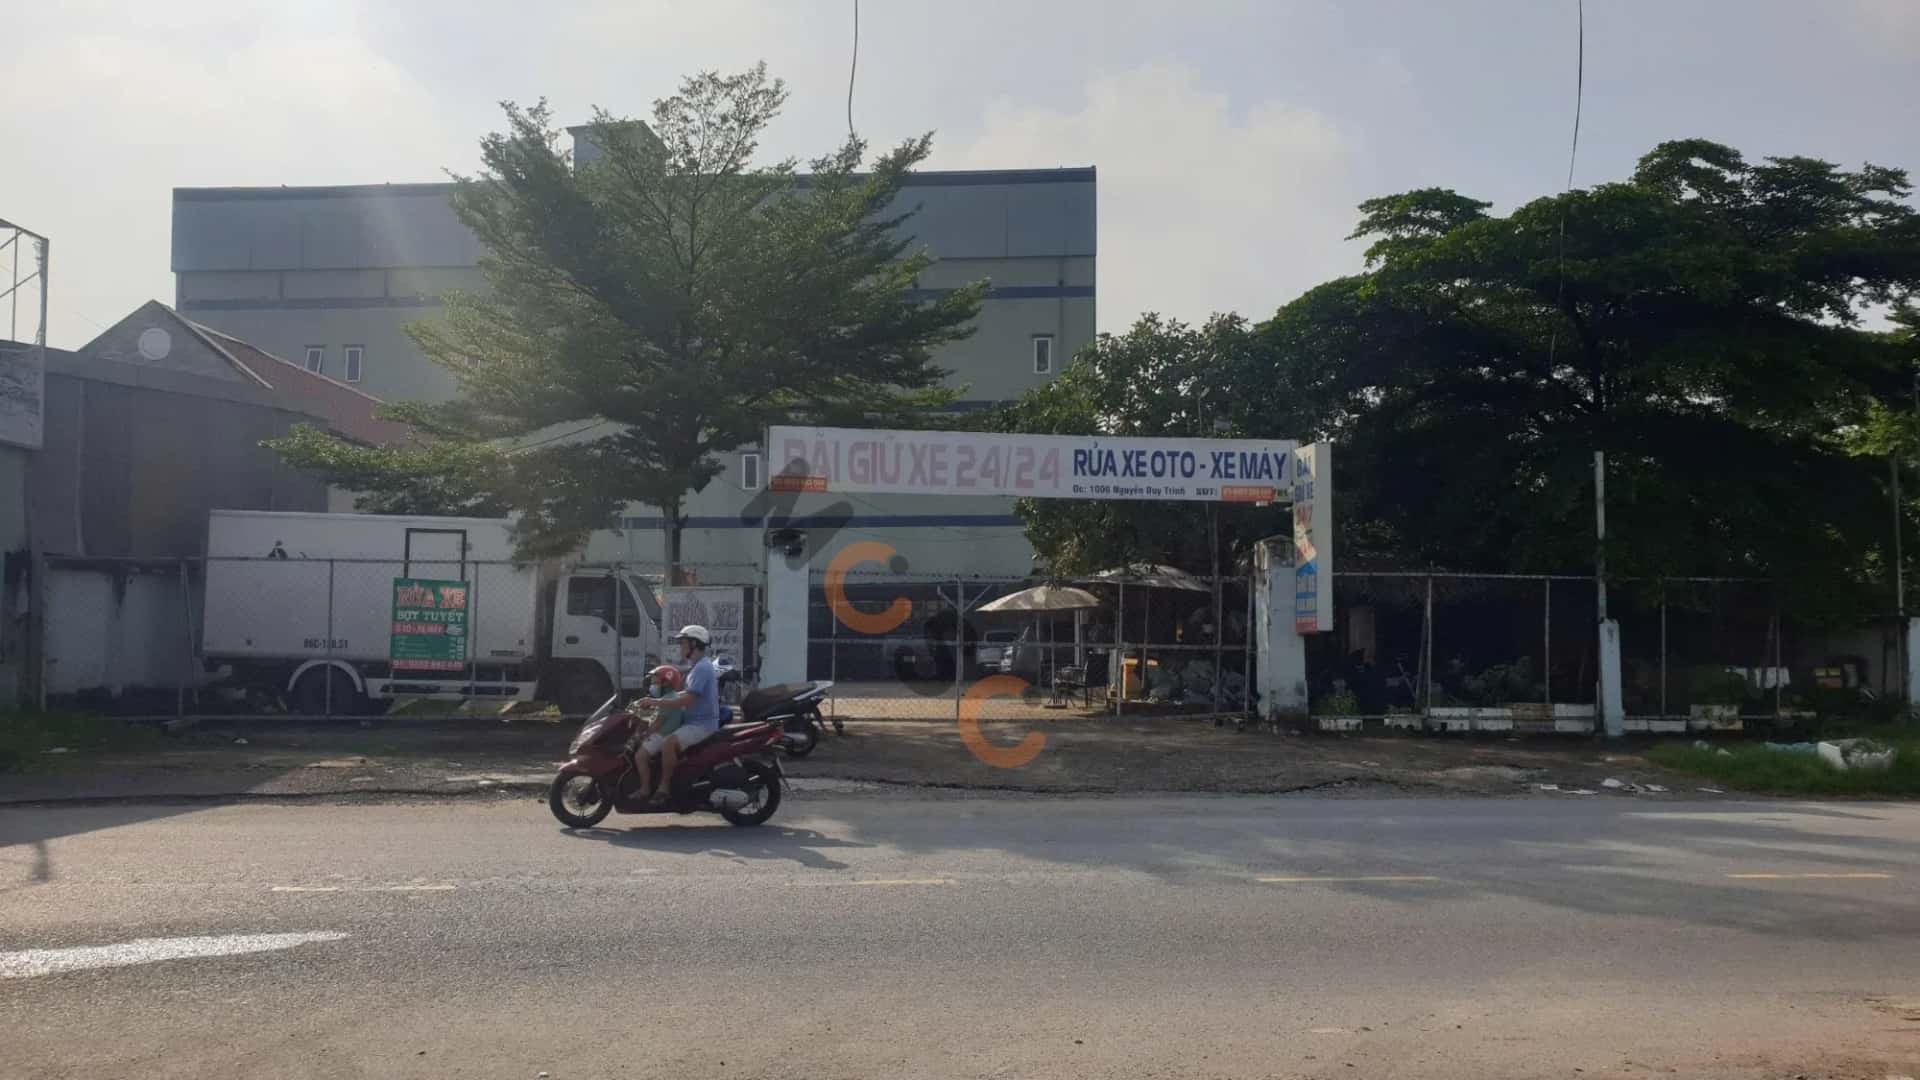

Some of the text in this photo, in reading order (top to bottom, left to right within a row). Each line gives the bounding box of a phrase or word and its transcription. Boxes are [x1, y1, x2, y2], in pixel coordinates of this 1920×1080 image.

[907, 442, 949, 487] XE
[956, 444, 1060, 490] 24/24
[1073, 441, 1117, 478] RỬA
[1121, 449, 1147, 478] XE
[1150, 450, 1195, 479] OTO
[1210, 451, 1235, 480] XE
[1239, 446, 1287, 480] MÁY
[1146, 486, 1161, 497] Duy
